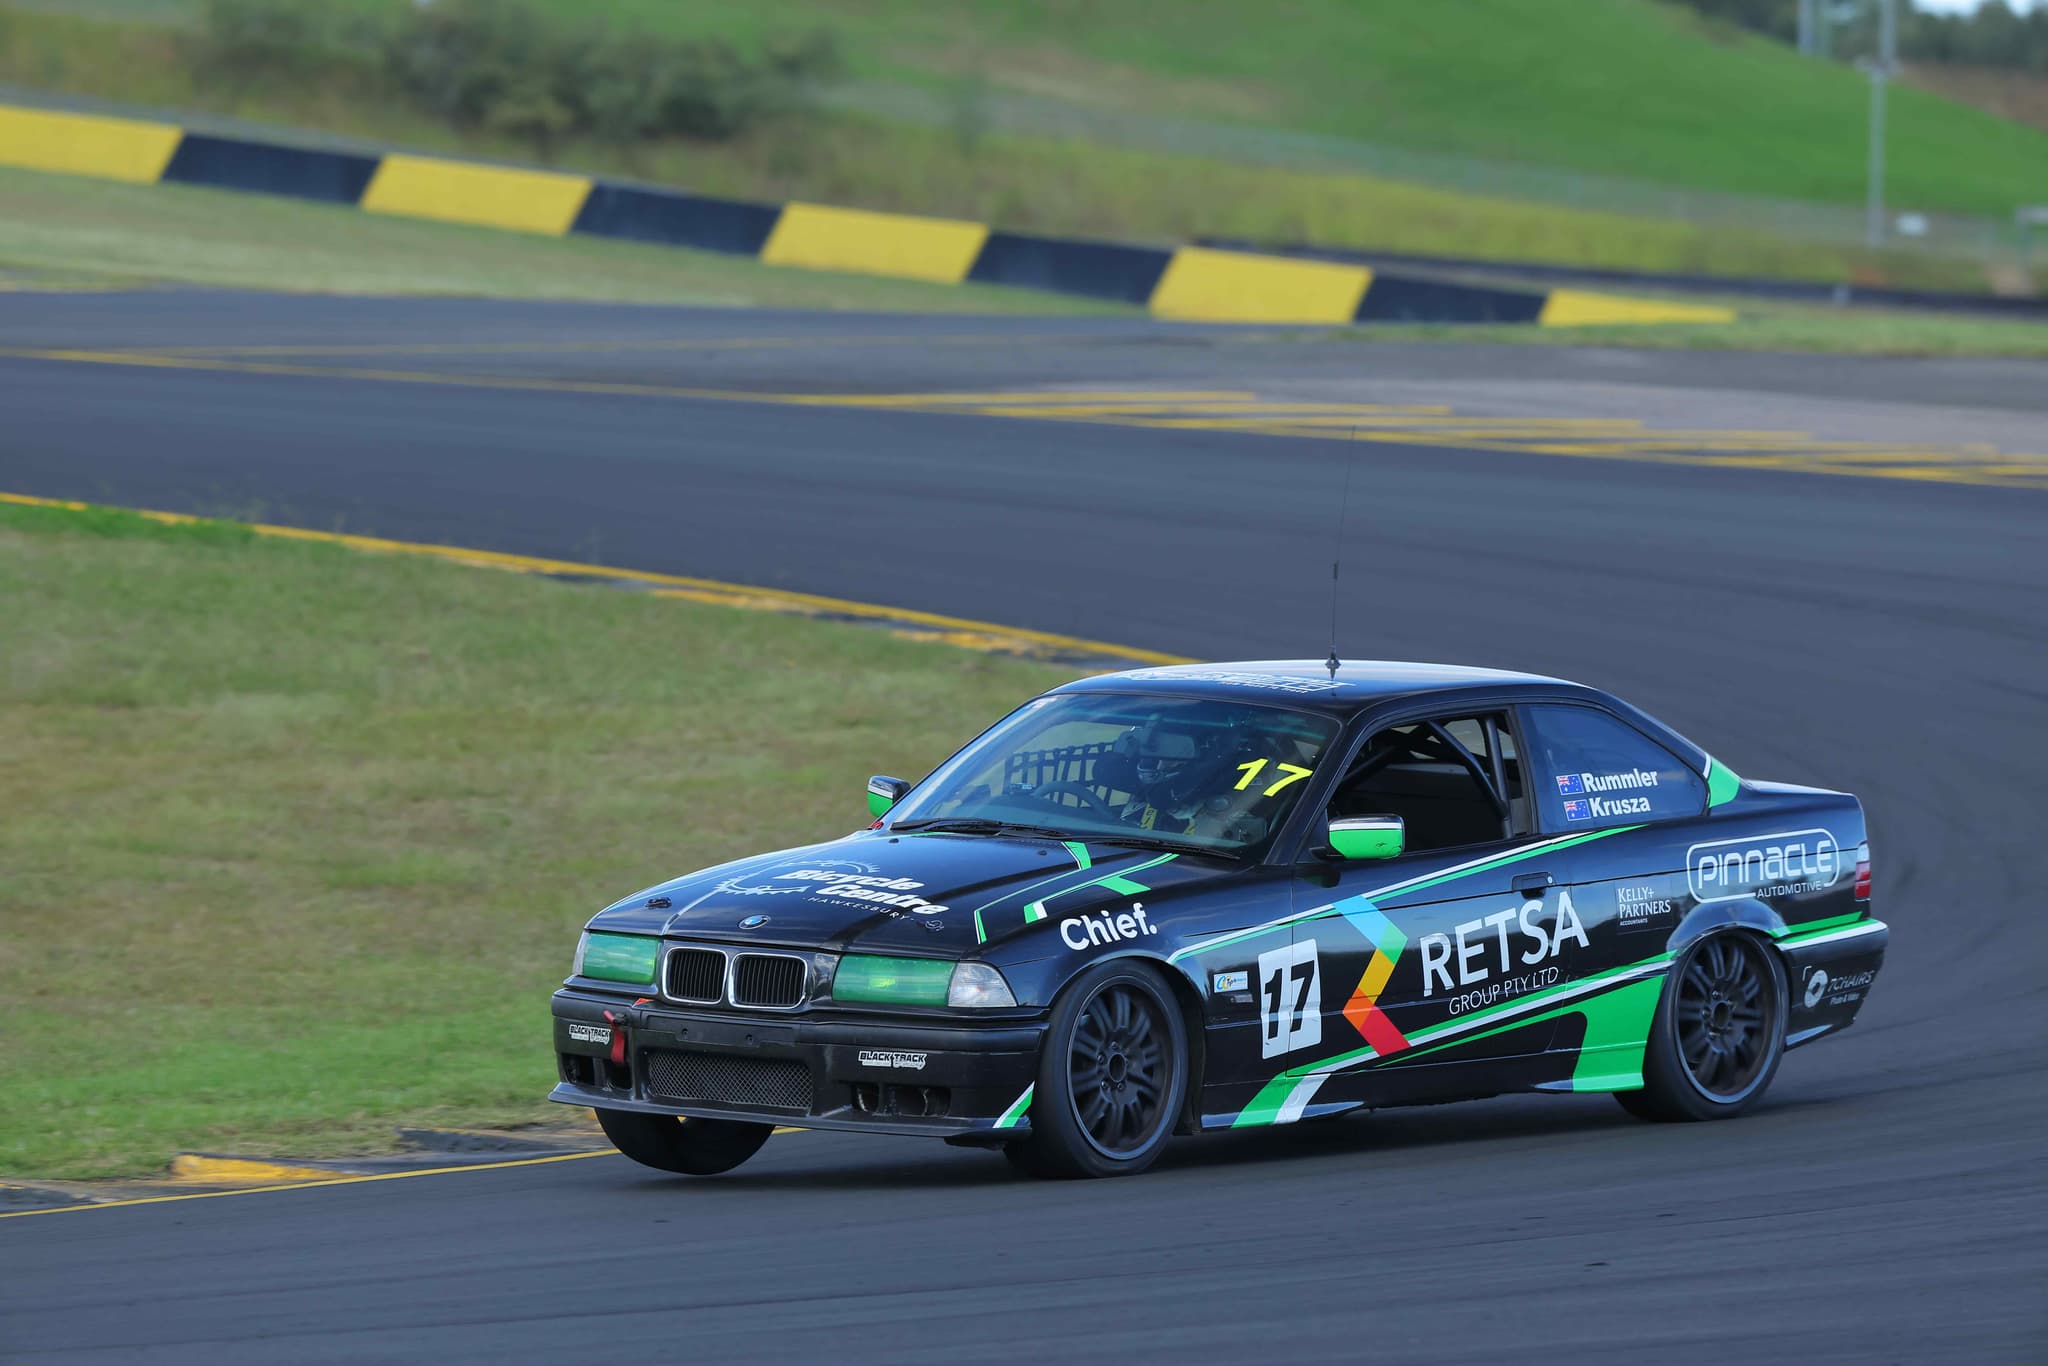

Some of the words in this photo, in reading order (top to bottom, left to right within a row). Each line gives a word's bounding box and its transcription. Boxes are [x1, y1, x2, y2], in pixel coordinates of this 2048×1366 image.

[1233, 758, 1314, 797] 17
[1581, 768, 1658, 793] Rummler
[1589, 797, 1652, 817] Krusza
[773, 869, 924, 890] Bicycle
[1698, 840, 1832, 889] PINNACLE
[815, 884, 949, 914] Centre
[1756, 880, 1822, 898] AUTOMOTIVE
[1619, 899, 1671, 919] PARTNERS
[1060, 902, 1158, 951] Chief.
[1419, 890, 1590, 998] RETSA
[1264, 960, 1315, 1040] 17
[1449, 983, 1500, 1015] GROUP
[1504, 974, 1530, 998] PTY
[1532, 966, 1559, 988] LTD
[859, 1051, 891, 1062] BLACK
[893, 1053, 926, 1063] TRACK
